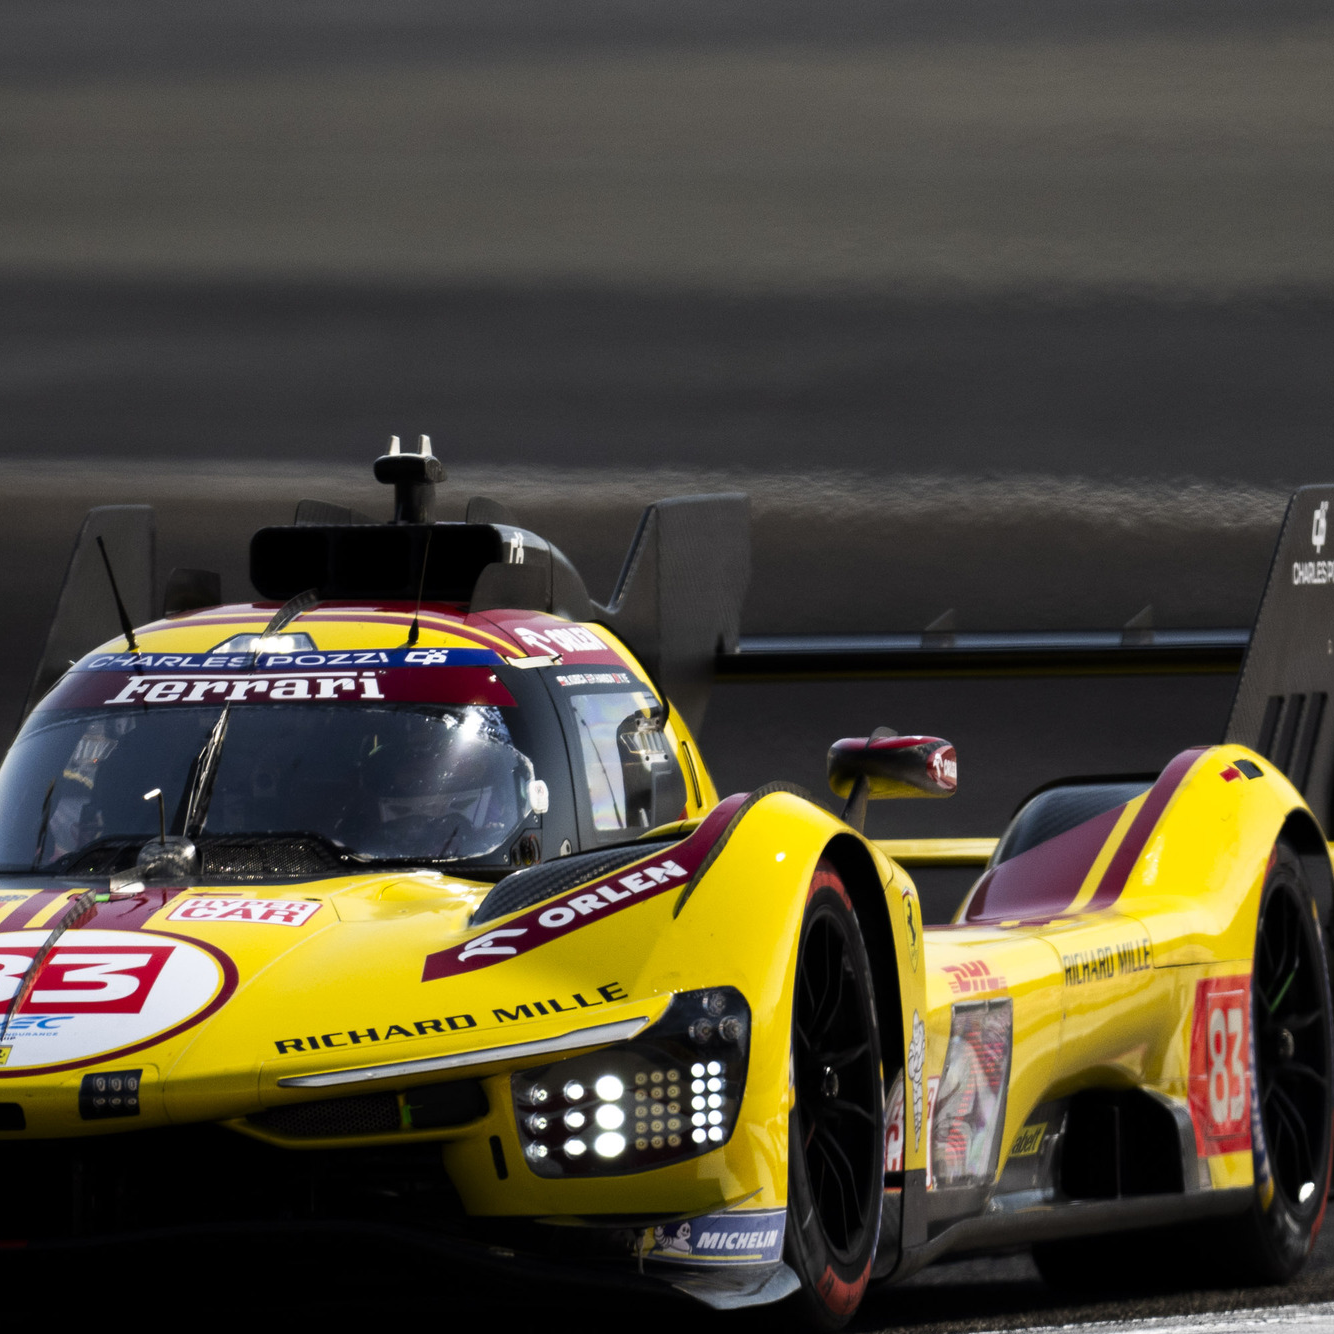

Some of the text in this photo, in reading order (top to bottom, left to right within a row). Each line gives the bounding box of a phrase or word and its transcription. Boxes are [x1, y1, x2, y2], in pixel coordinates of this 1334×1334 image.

[88, 655, 251, 668] CHARLES
[265, 652, 389, 667] POZZI
[104, 671, 385, 705] Ferrari
[190, 900, 309, 911] HYPER
[538, 860, 688, 928] ORLEN
[180, 907, 300, 923] CAR
[1062, 938, 1151, 987] RICHARD MILLE
[274, 982, 629, 1055] RICHARD MILLE
[1209, 1007, 1246, 1125] 83
[1010, 1127, 1042, 1154] abelt
[696, 1229, 779, 1250] MICHELIN
